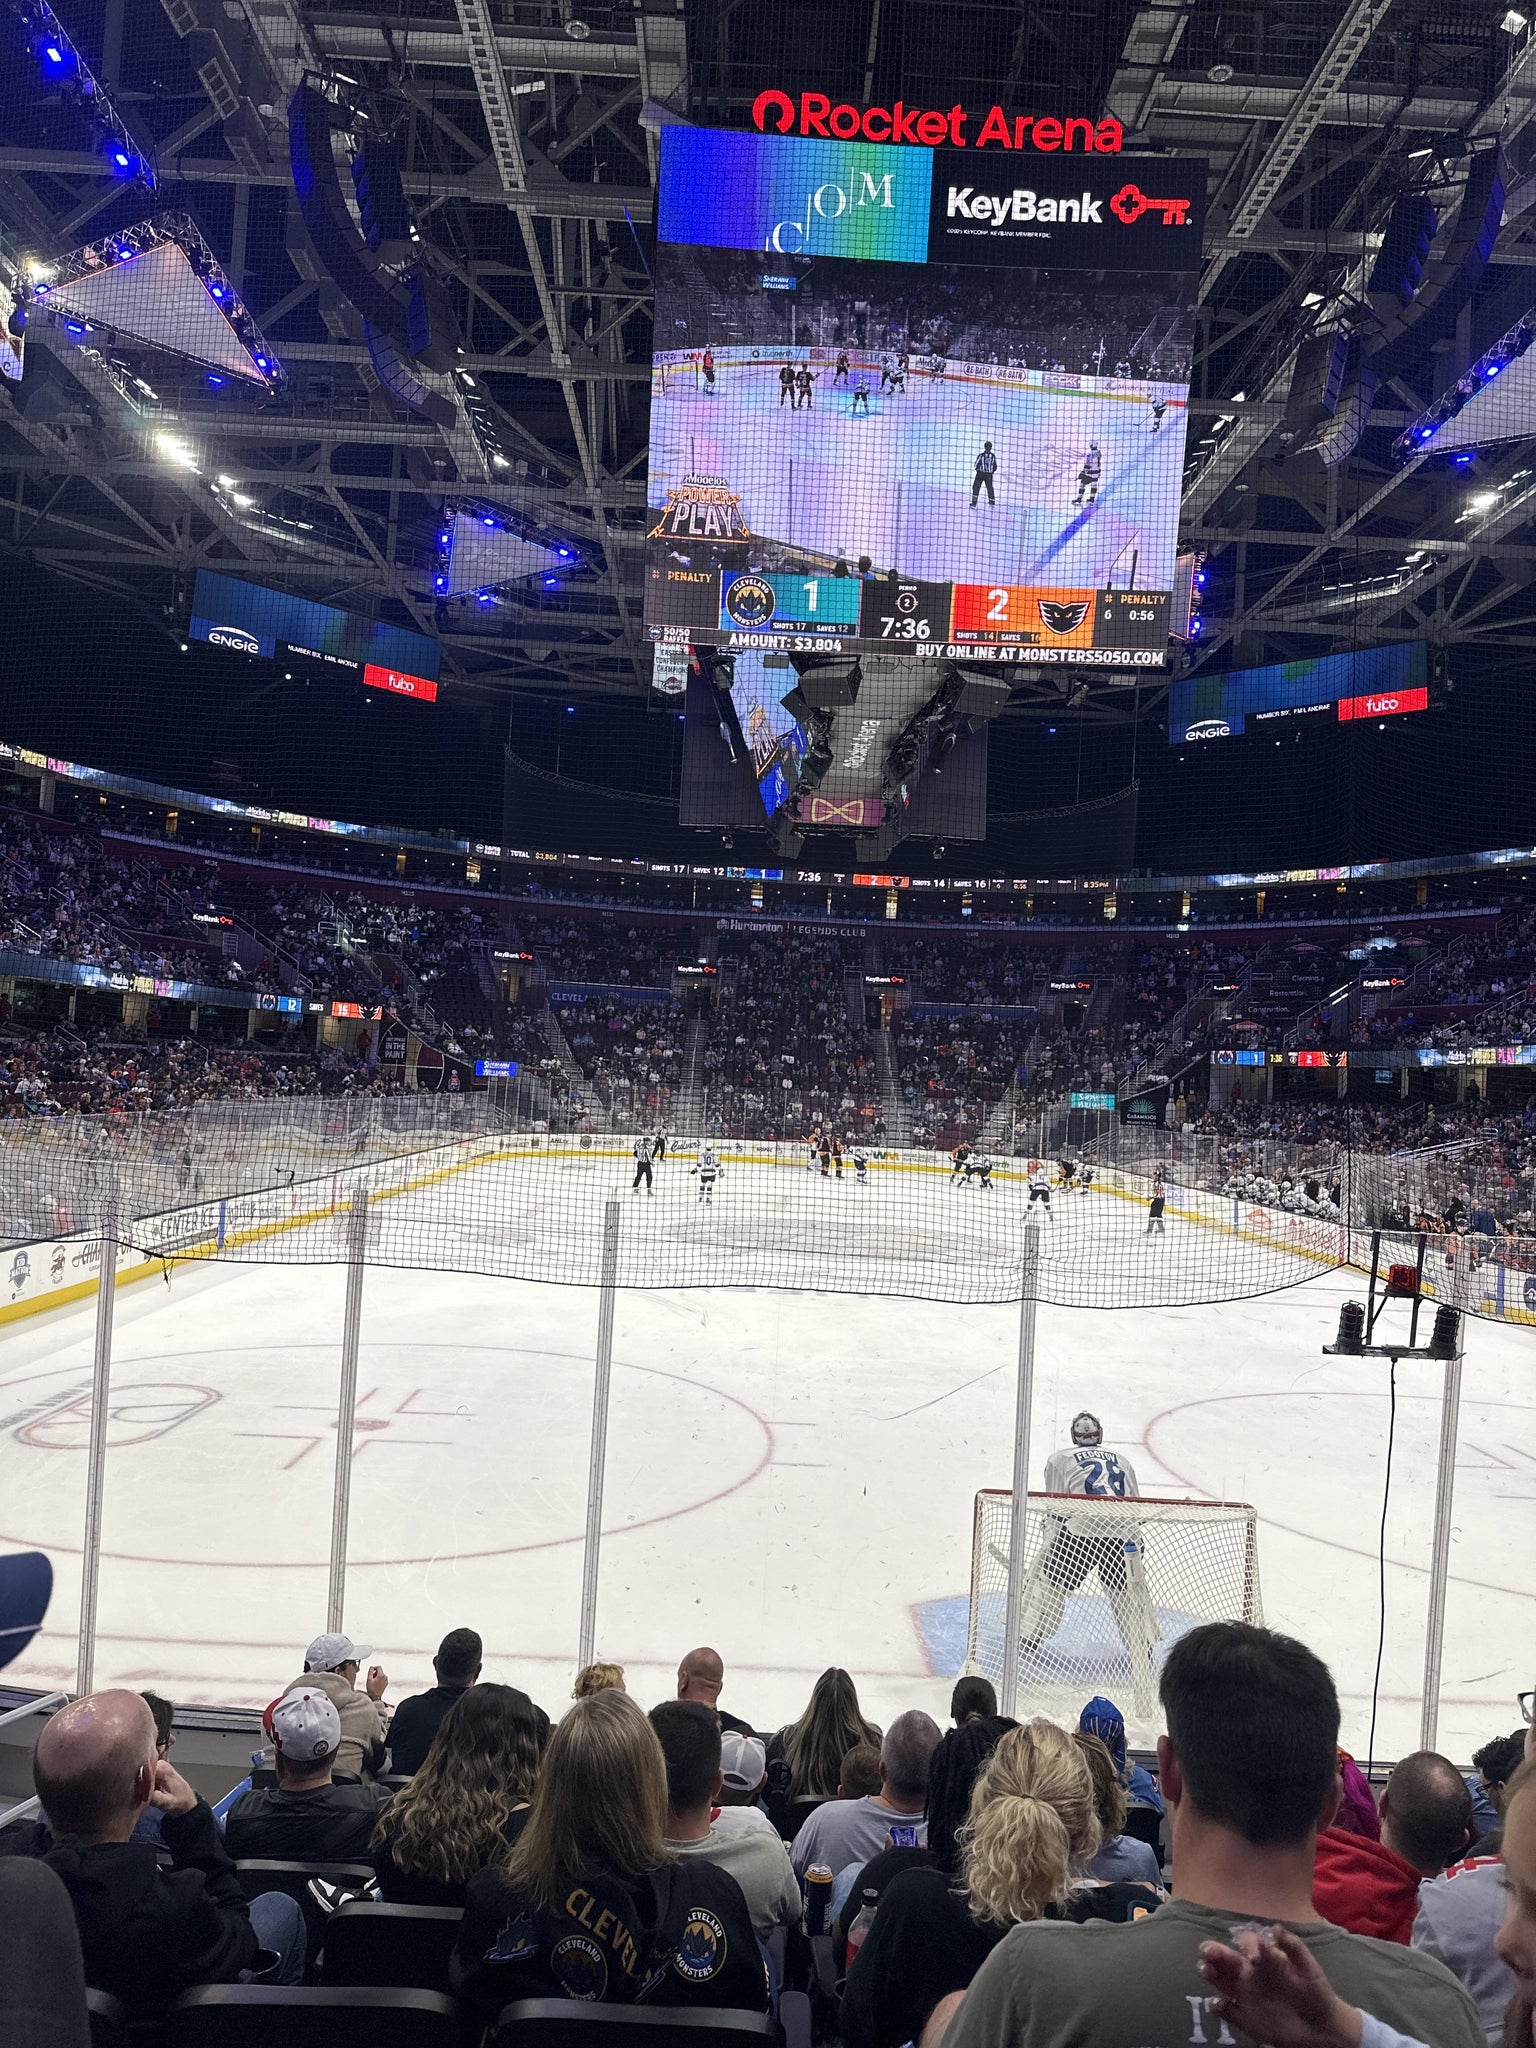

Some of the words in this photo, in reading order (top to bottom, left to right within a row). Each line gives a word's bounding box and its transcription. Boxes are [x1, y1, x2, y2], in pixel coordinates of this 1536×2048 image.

[799, 91, 968, 147] Rocket
[975, 105, 1123, 153] Arena
[947, 186, 1103, 227] KeyBank
[679, 486, 731, 504] POWER
[671, 502, 733, 537] PLAY
[667, 570, 713, 583] PENALTY
[733, 578, 769, 594] CLEVELAND
[803, 579, 818, 612] 1
[904, 598, 910, 607] 2
[1120, 594, 1166, 605] PENALTY
[986, 588, 1009, 621] 2
[732, 611, 767, 626] MONSTERS
[1104, 610, 1112, 620] 6
[1129, 610, 1155, 621] 0:56
[663, 627, 691, 637] 50/50
[772, 622, 794, 630] SHOTS
[796, 623, 807, 631] 17
[816, 624, 837, 633] SAVES
[838, 624, 849, 633] 12
[880, 616, 931, 640] 7:36
[728, 633, 792, 650] AMOUNT:
[794, 636, 843, 652] $3,804
[956, 631, 978, 640] SHOTS
[983, 631, 994, 640] 14
[1000, 633, 1021, 641] SAVES
[915, 643, 945, 657] BUY
[946, 645, 997, 659] ONLINE
[998, 648, 1017, 660] AT
[1018, 648, 1164, 665] MONSTERS5050.COM
[387, 674, 415, 693] fubo
[1366, 698, 1399, 714] fubo
[510, 849, 531, 858] TOTAL
[651, 864, 671, 872] SHOTS
[673, 864, 686, 873] 17
[713, 867, 725, 876] 12
[759, 869, 766, 880] 1
[797, 871, 822, 882] 7:36
[912, 879, 931, 887] SHOTS
[933, 879, 945, 888] 14
[974, 880, 987, 888] 16
[192, 913, 220, 924] KeyBank
[840, 927, 866, 937] CLUB
[494, 950, 520, 960] KeyBank
[677, 965, 703, 974] KeyBank
[865, 975, 891, 984] KeyBank
[1050, 982, 1077, 990] KeyBank
[1362, 979, 1391, 988] KeyBank
[308, 1002, 324, 1012] SAVES
[384, 1050, 405, 1059] PAINT
[1076, 1450, 1117, 1463] FEDOTOV
[1080, 1460, 1126, 1497] 28
[687, 1911, 722, 1939] LEVELAND
[558, 1938, 601, 1963] CLEVELAND
[675, 1953, 714, 1978] MONSTERS
